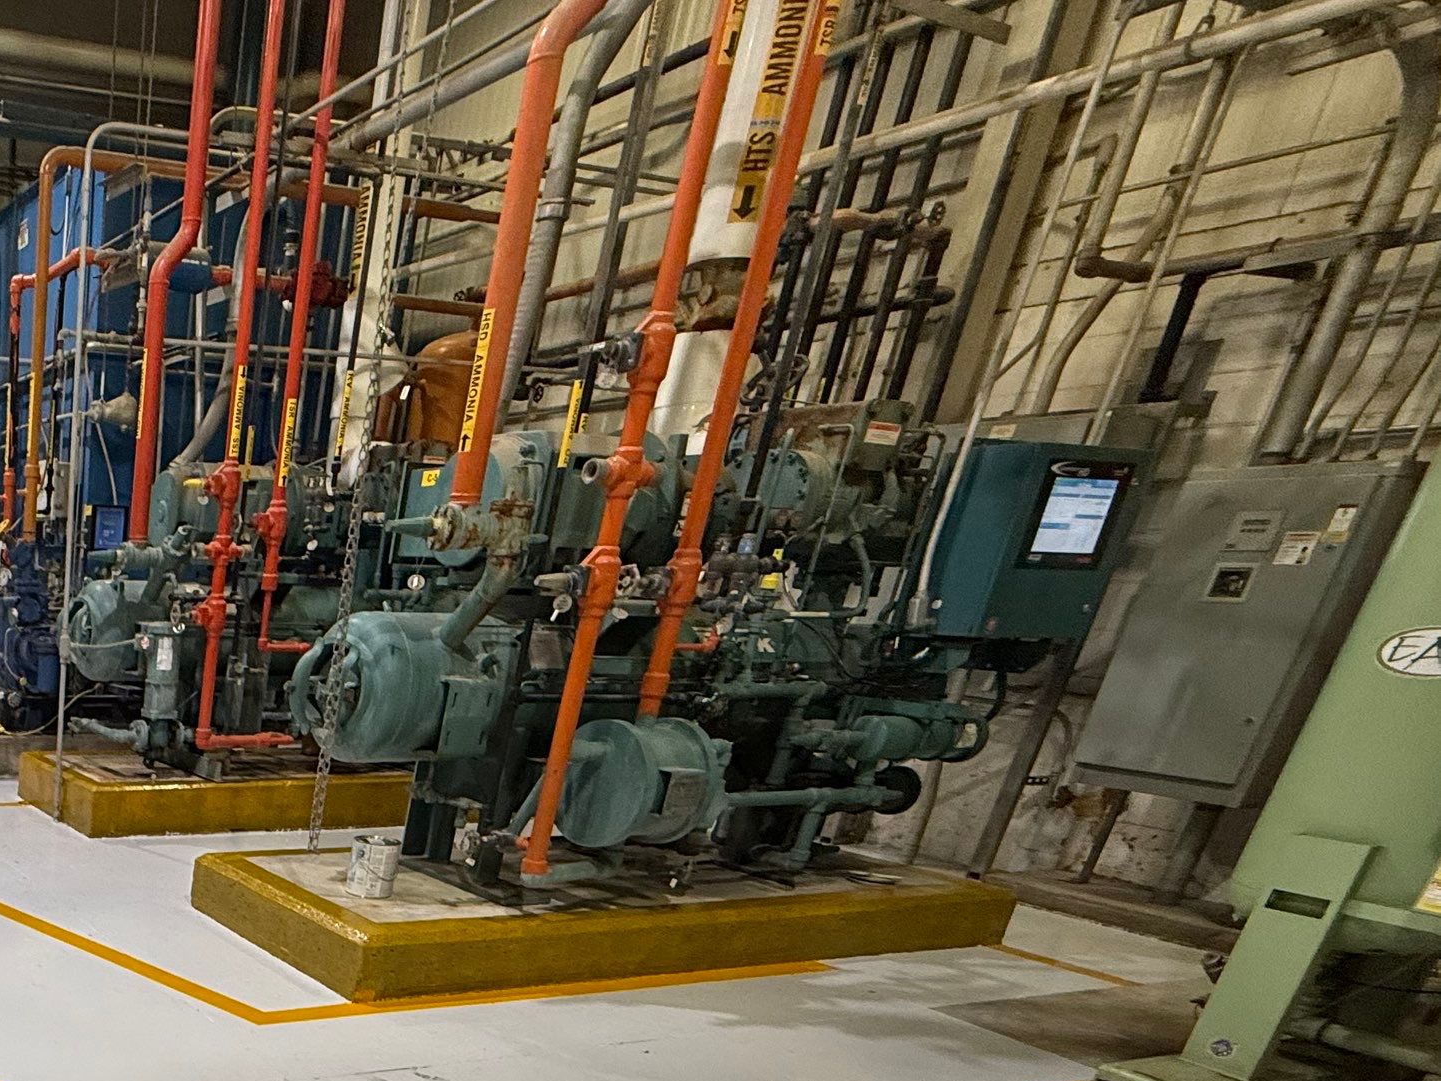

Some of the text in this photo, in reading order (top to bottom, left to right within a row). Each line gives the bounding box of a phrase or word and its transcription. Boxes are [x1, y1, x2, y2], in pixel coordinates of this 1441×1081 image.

[742, 132, 776, 172] HTS
[353, 185, 371, 261] AMMONIA
[464, 312, 492, 423] HSD AMMONIA
[231, 386, 245, 455] TSS AMMONIA
[339, 396, 350, 439] AMMONIA
[282, 426, 293, 468] AMMONIA
